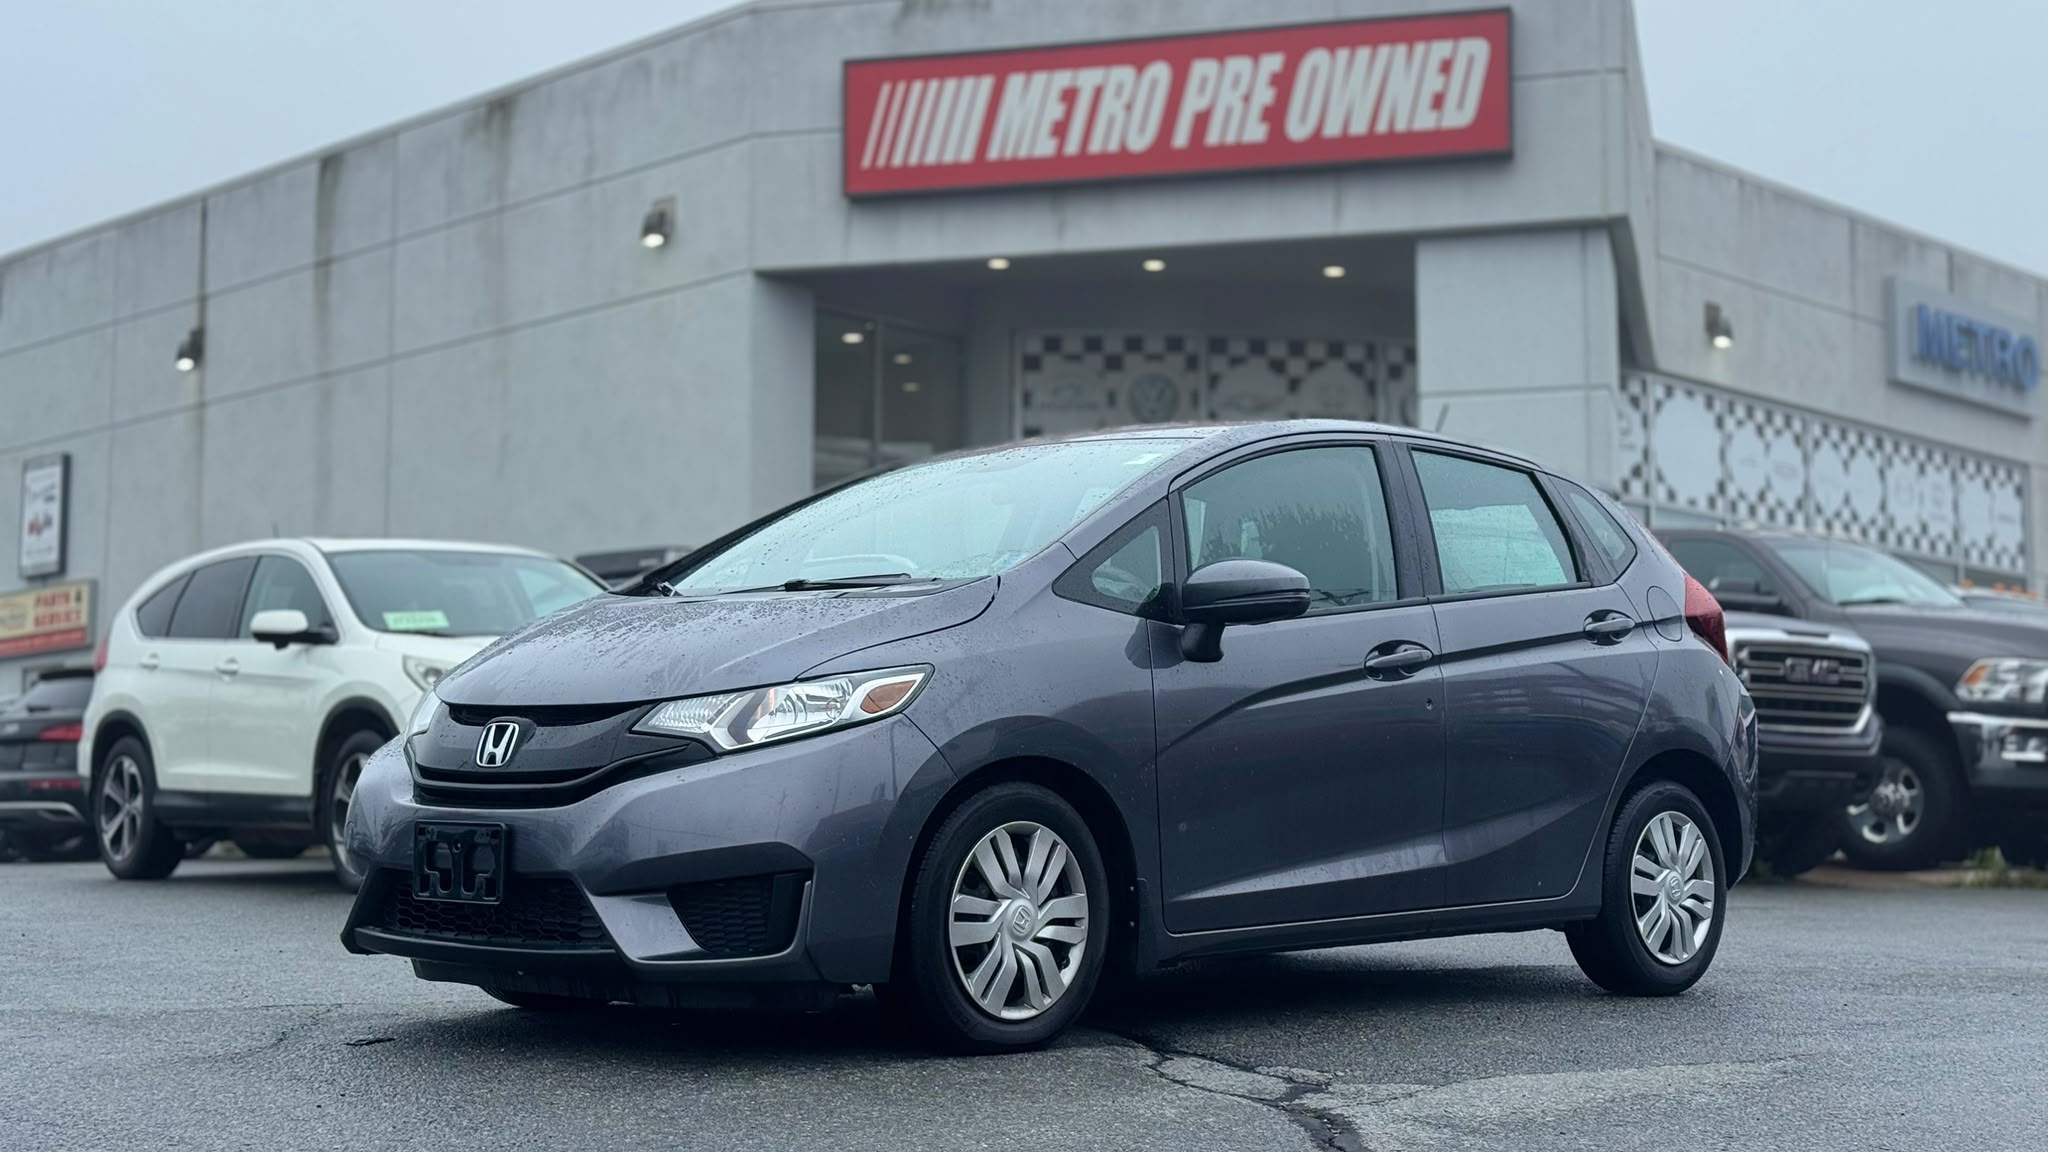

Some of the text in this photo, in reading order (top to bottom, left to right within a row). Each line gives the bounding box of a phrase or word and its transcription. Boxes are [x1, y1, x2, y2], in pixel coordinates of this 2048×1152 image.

[986, 37, 1491, 162] METRO PRE OWNED
[1916, 303, 2041, 390] METRO
